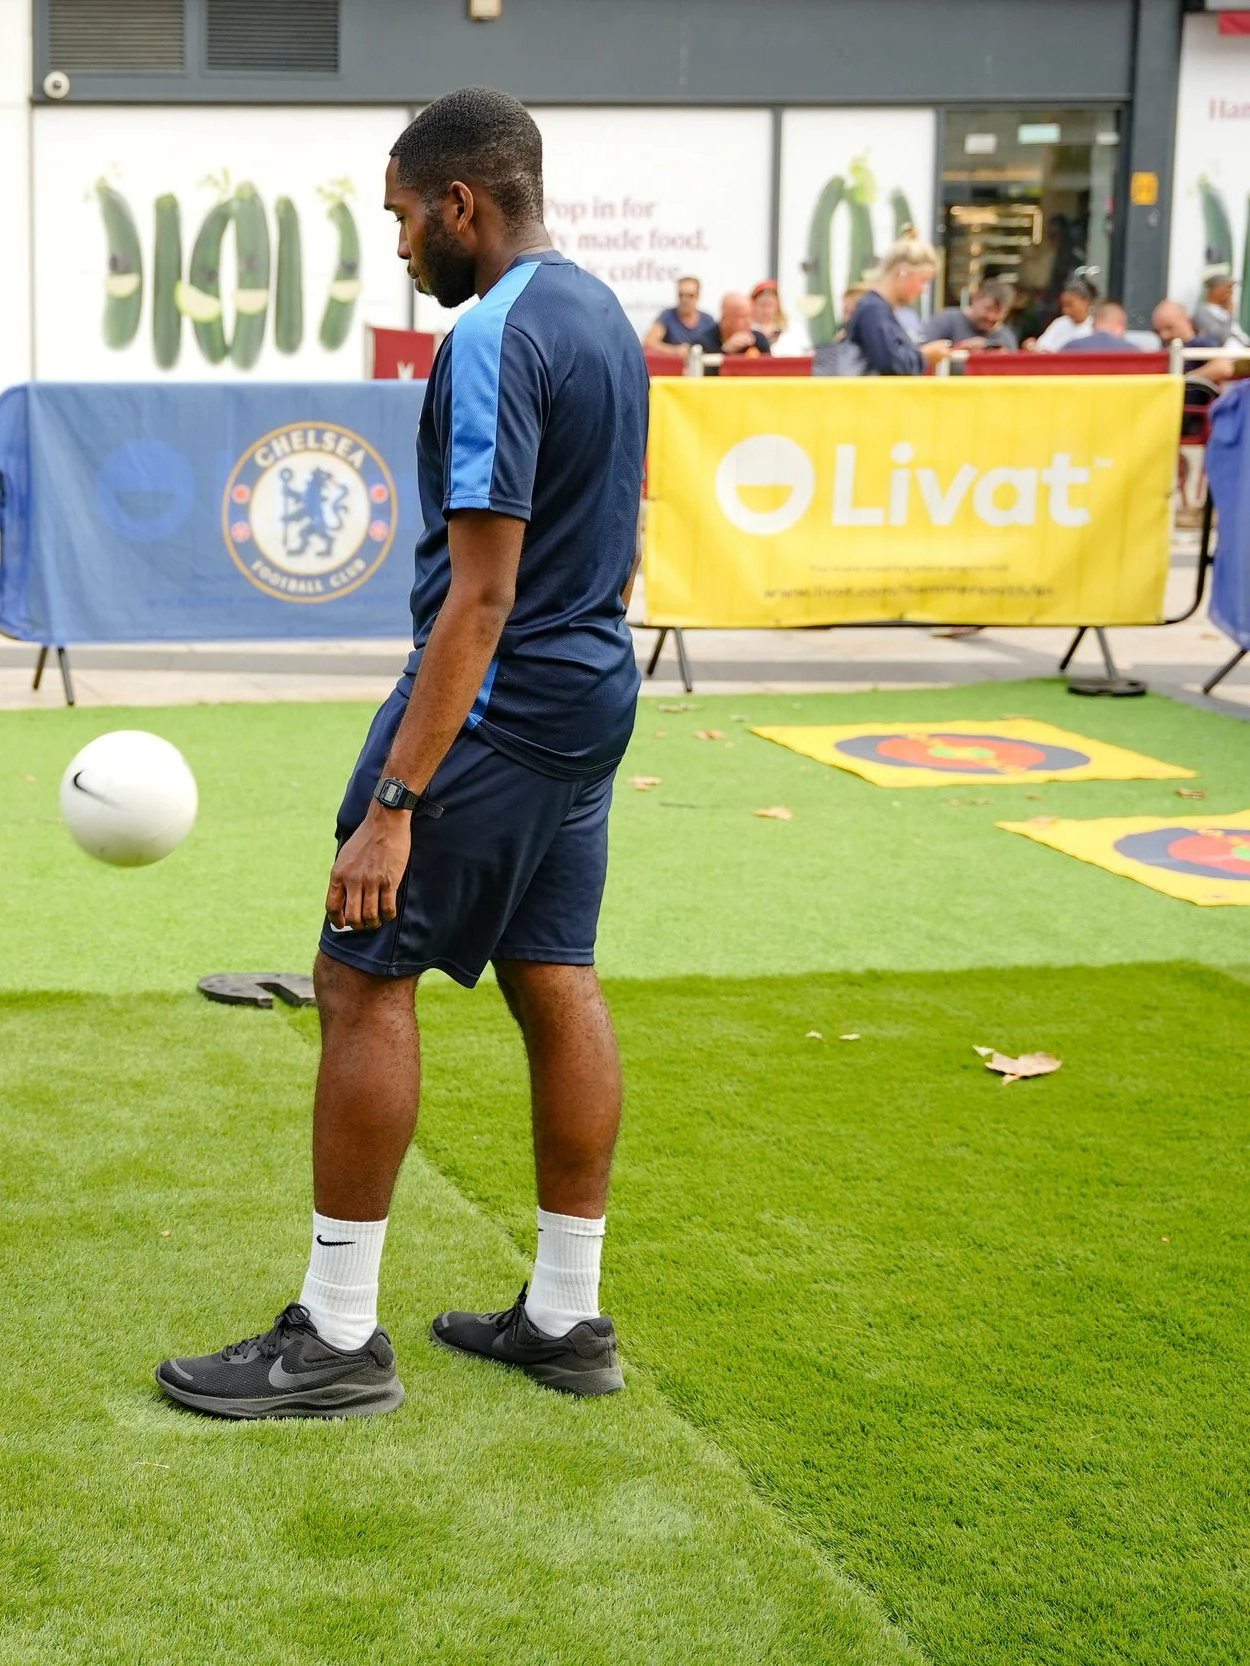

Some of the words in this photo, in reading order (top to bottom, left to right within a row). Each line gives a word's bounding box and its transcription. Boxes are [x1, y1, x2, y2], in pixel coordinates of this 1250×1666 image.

[592, 194, 617, 219] in
[622, 194, 657, 219] for
[577, 229, 643, 250] made
[253, 428, 366, 469] CHELSEA
[251, 559, 324, 593] FOOTBALL
[329, 557, 367, 588] CLUB
